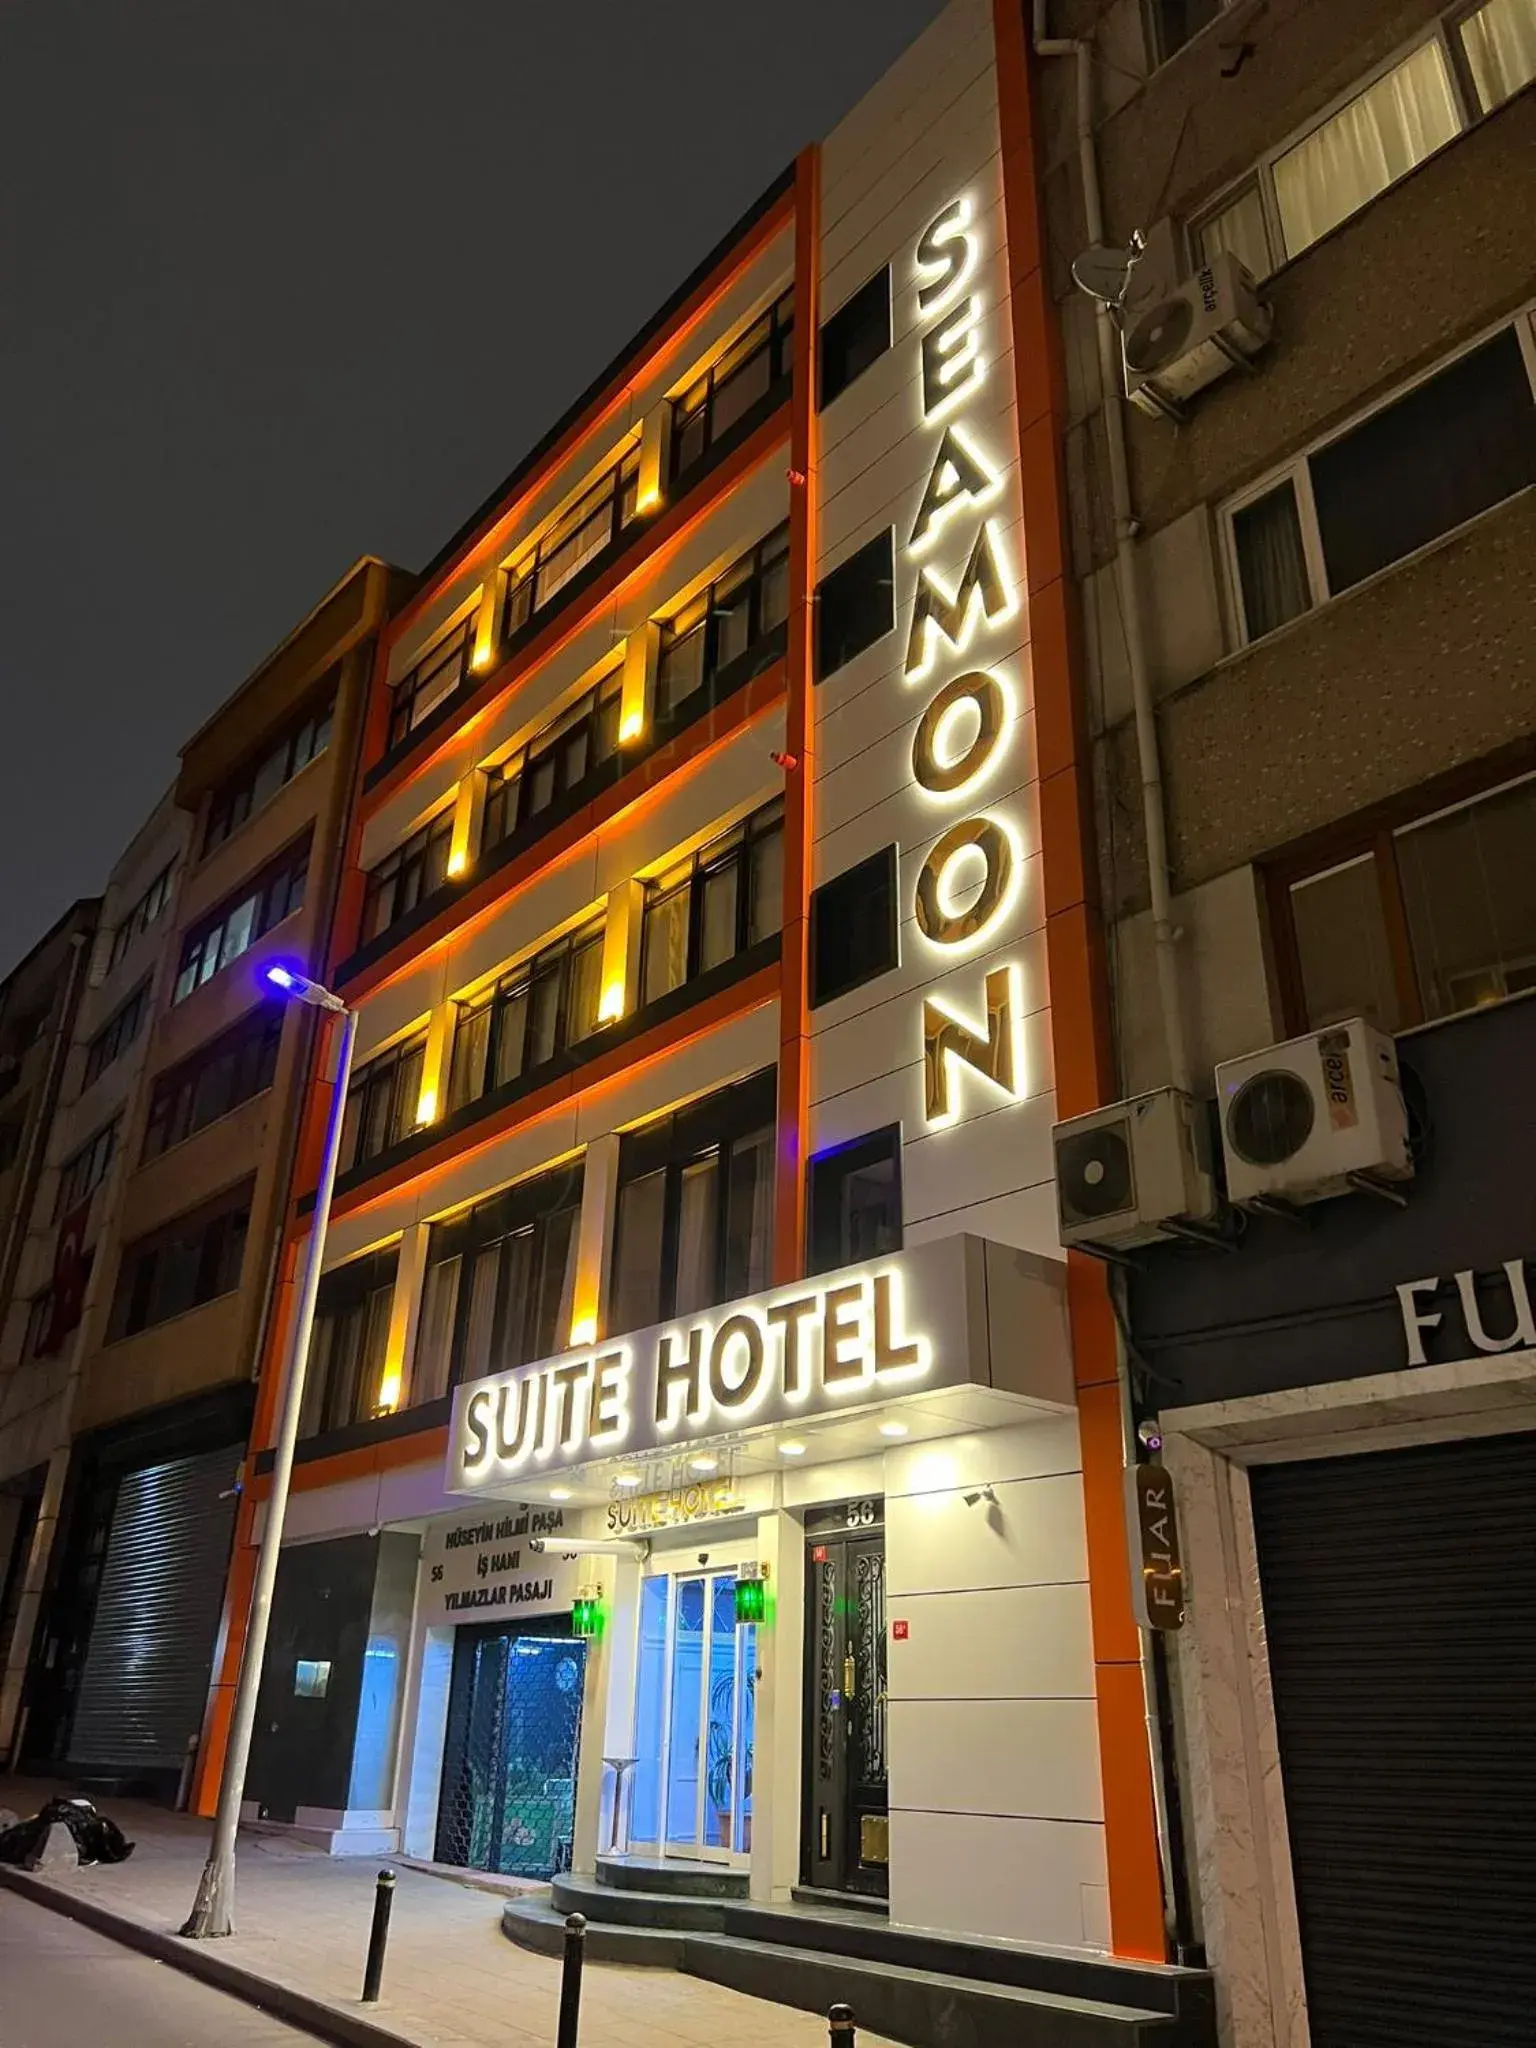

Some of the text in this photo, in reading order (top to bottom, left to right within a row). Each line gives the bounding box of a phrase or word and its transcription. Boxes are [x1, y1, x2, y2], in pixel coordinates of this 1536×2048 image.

[904, 198, 1022, 1126] SEAMOON
[463, 1273, 921, 1469] SUITE HOTEL
[531, 1508, 564, 1534] PAŞA
[846, 1499, 875, 1528] 56
[1146, 1487, 1177, 1607] FUAR
[430, 1564, 444, 1583] 56
[476, 1554, 489, 1579] İŞ
[444, 1578, 554, 1611] YILMAZLAR PASAJI
